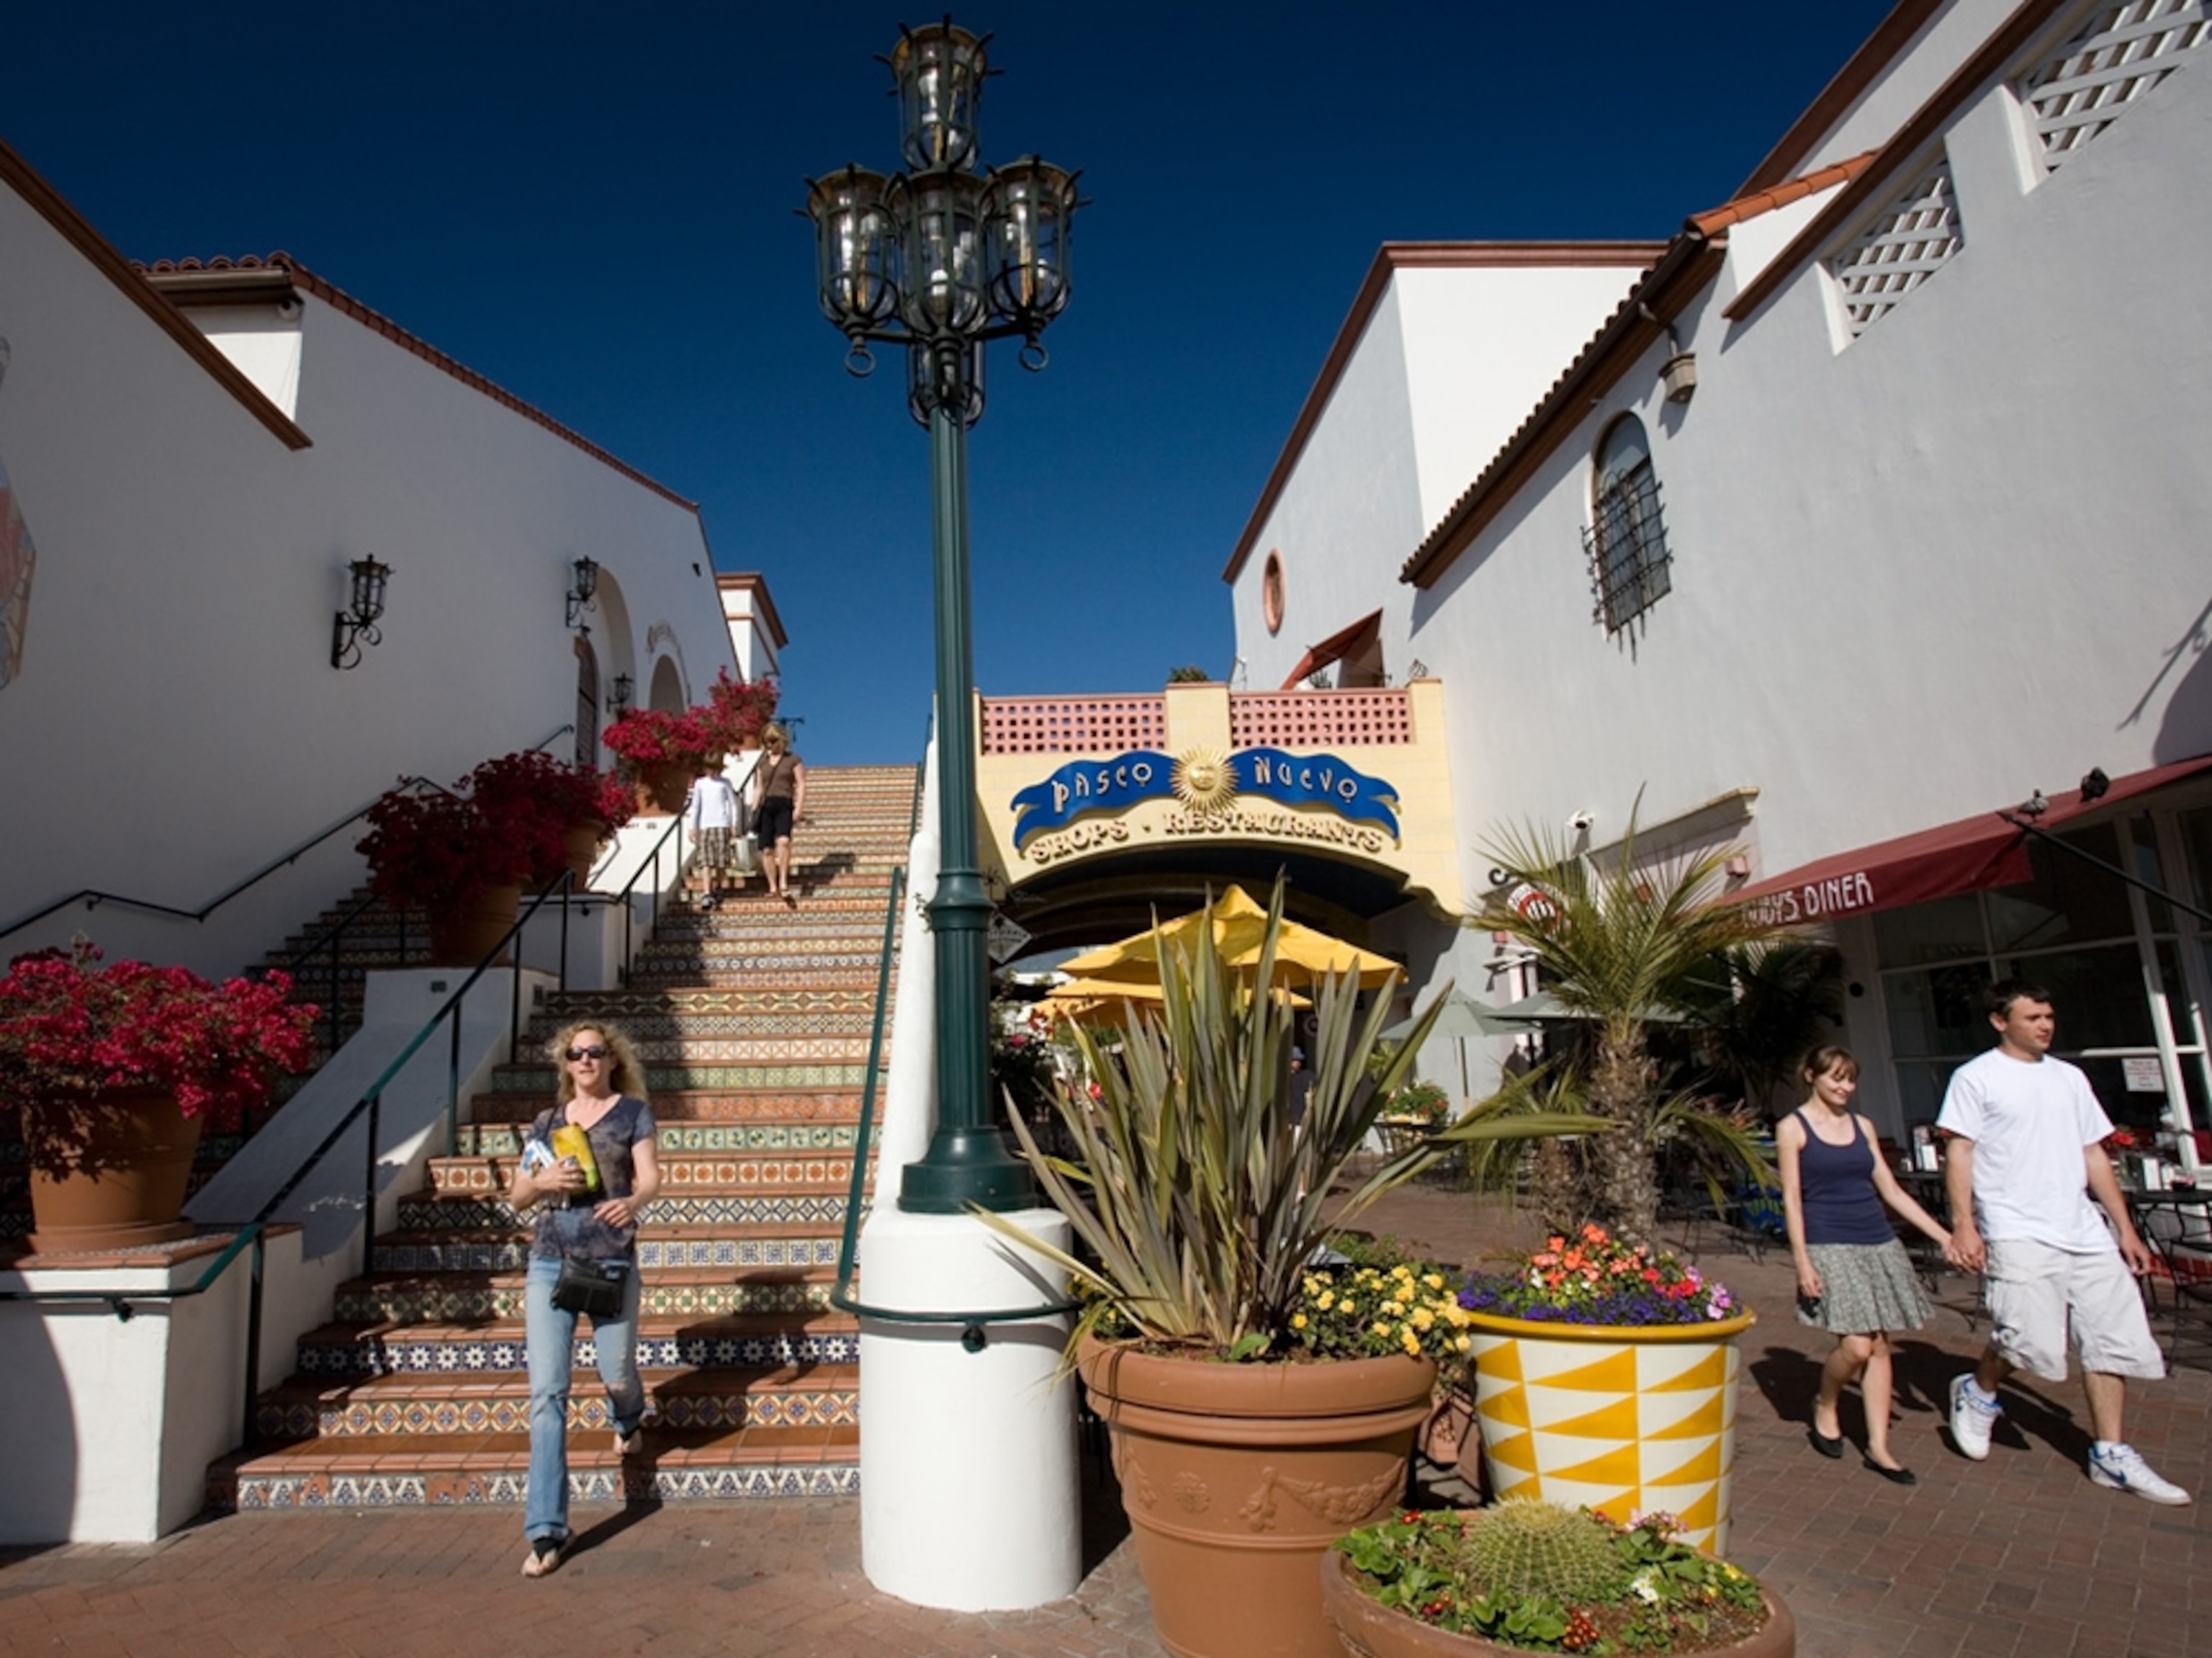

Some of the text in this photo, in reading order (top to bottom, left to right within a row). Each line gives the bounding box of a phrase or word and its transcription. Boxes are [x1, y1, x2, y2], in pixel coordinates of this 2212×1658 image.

[1032, 811, 1382, 864] SHOPS RESTAURANTS
[1803, 871, 1875, 916] DINER
